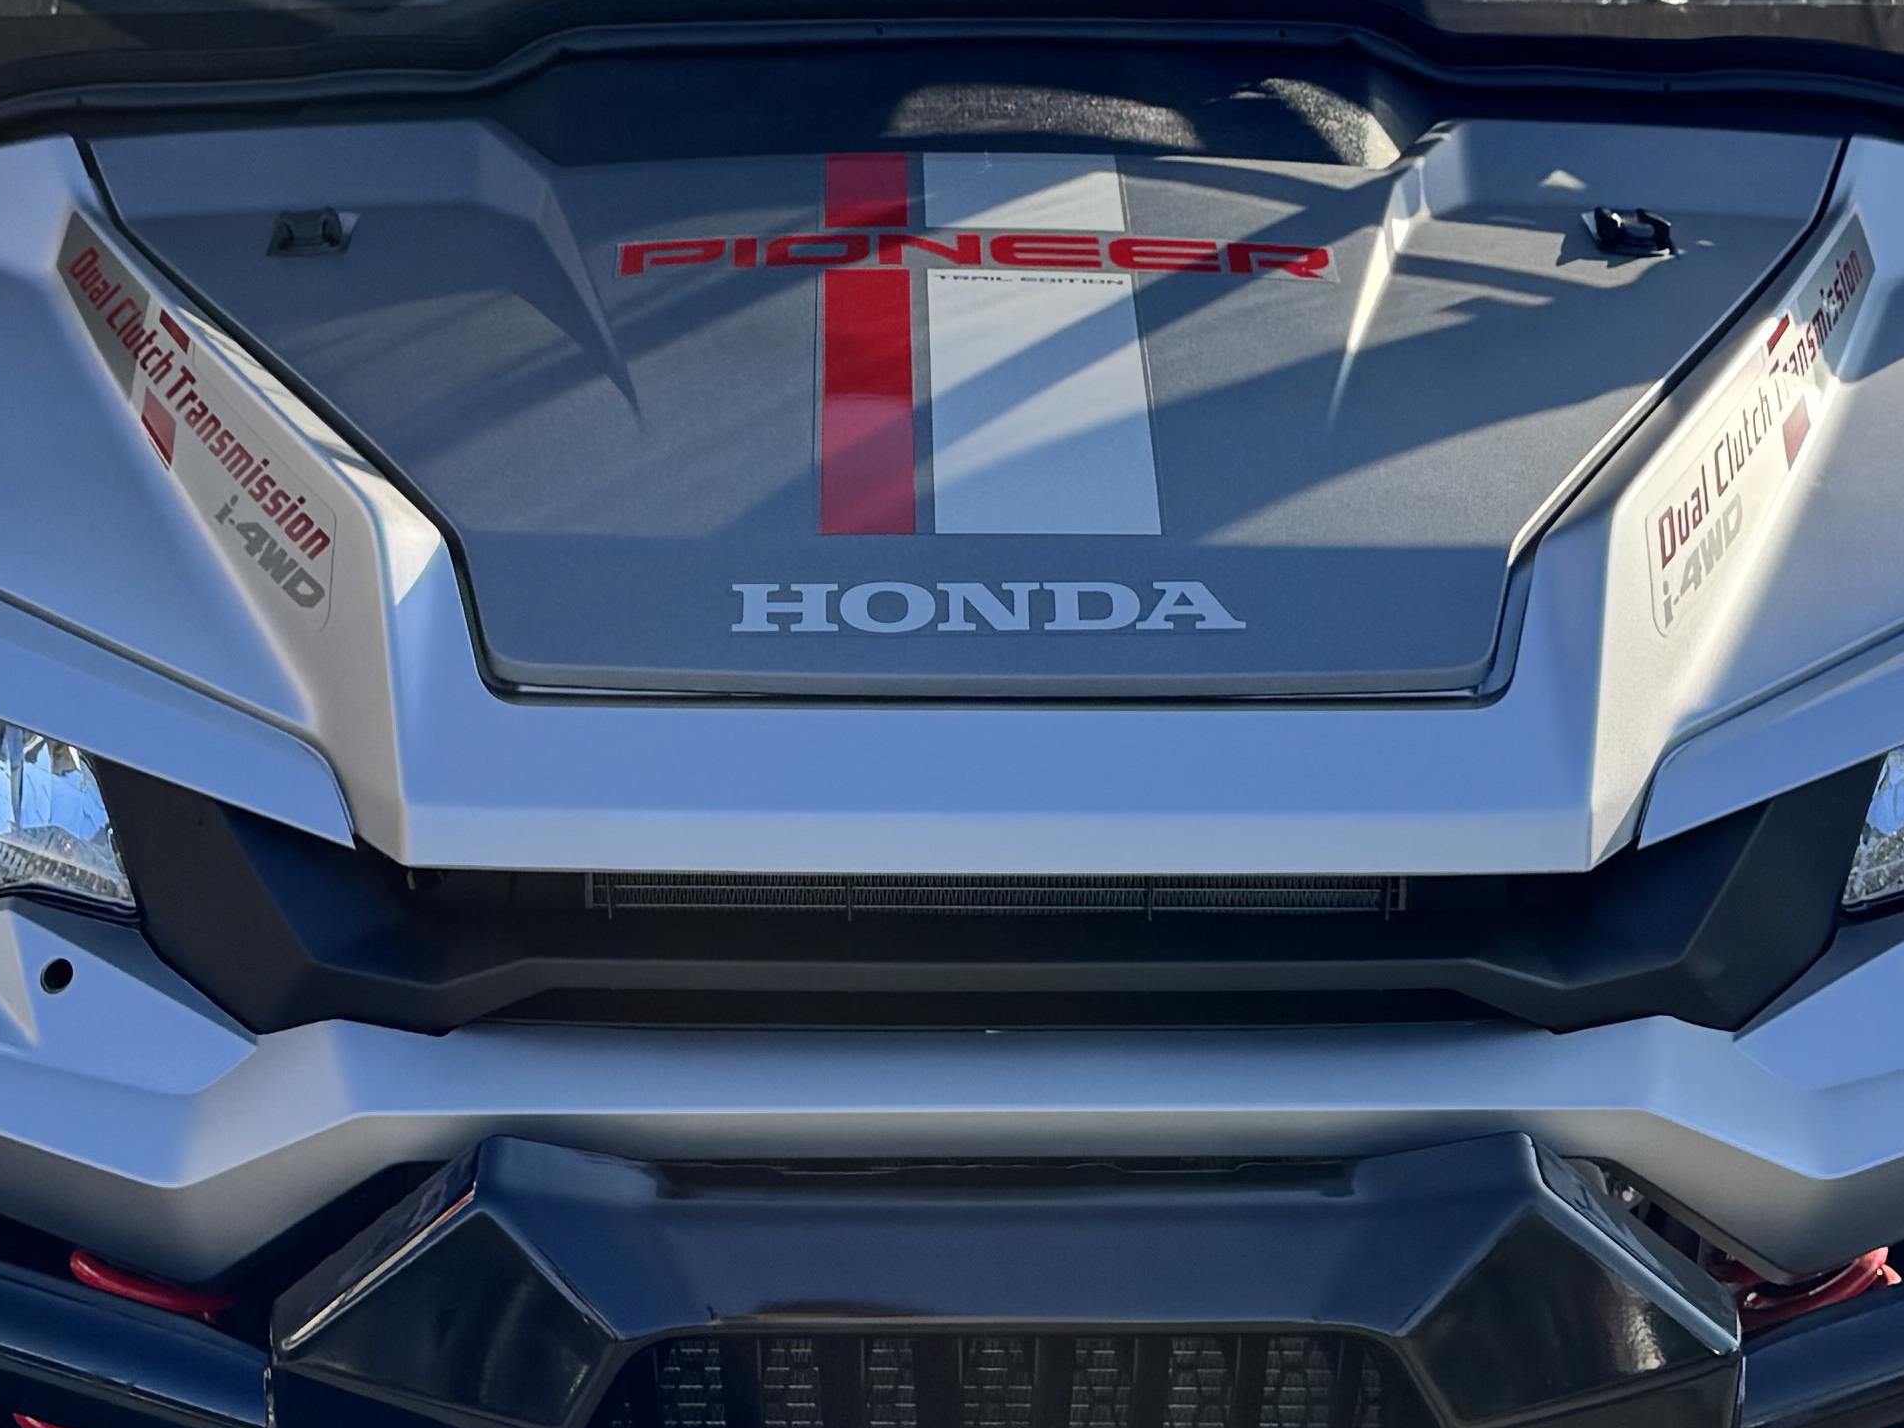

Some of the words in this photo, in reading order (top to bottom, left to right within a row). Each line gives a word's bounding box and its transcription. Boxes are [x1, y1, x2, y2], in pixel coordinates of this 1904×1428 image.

[620, 233, 1334, 280] PIONEER
[934, 274, 1013, 283] TRAIL
[1020, 276, 1124, 285] EDITION
[68, 246, 115, 312] Dual
[105, 298, 173, 385] Clutch
[164, 366, 331, 560] Transmission
[1658, 464, 1710, 569] Dual
[1714, 386, 1772, 497] Clutch
[215, 495, 325, 609] i-4WD
[732, 582, 1246, 633] HONDA
[1663, 493, 1743, 628] i-4WD
